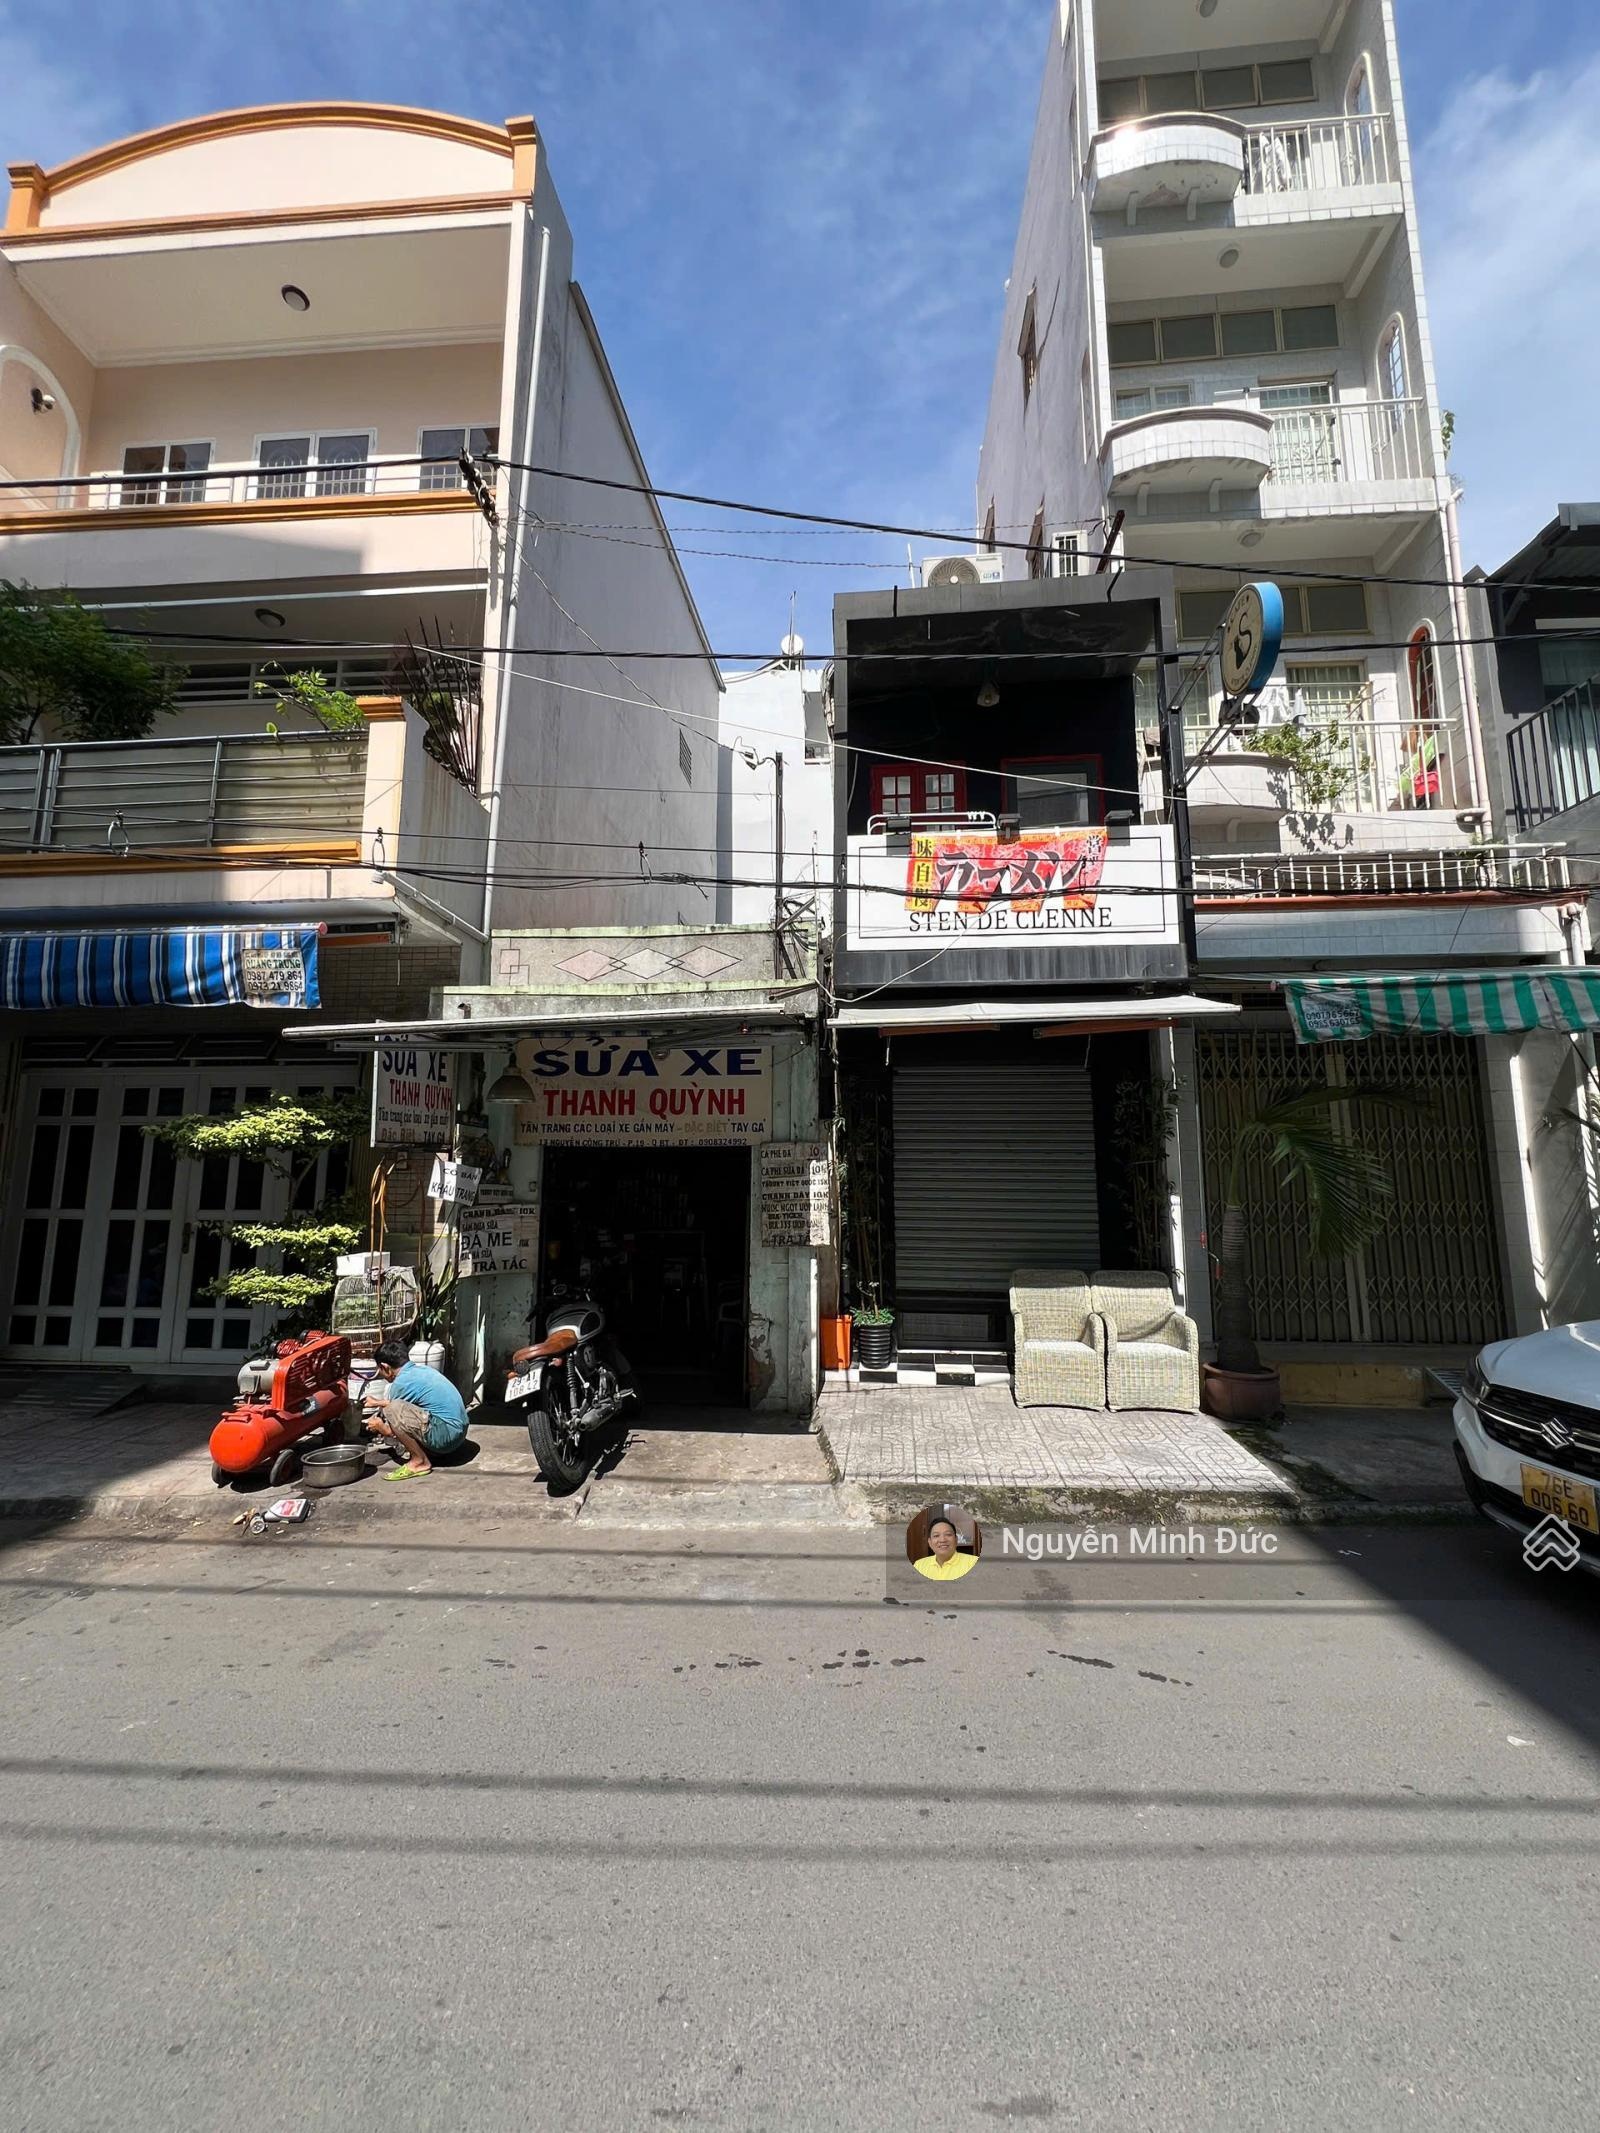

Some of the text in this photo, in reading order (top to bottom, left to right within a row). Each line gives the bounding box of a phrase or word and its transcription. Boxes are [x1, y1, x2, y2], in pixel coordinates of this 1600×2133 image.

[909, 907, 1112, 932] STEN DE CLENNE
[245, 959, 301, 969] QUANG TRUNG
[246, 970, 266, 981] 0987
[269, 970, 285, 981] 479
[248, 981, 269, 991] 0973
[270, 981, 282, 991] 21
[531, 1036, 762, 1077] SỬA XE
[389, 1079, 421, 1108] THANH
[543, 1082, 745, 1120] THANH QUỲNH
[541, 1123, 571, 1134] TRANG
[619, 1123, 630, 1134] XE
[519, 1207, 535, 1215] 10K
[461, 1230, 482, 1250] ĐÁ
[487, 1231, 513, 1248] ME
[1541, 1472, 1575, 1500] 76E
[1530, 1487, 1590, 1526] 006.60
